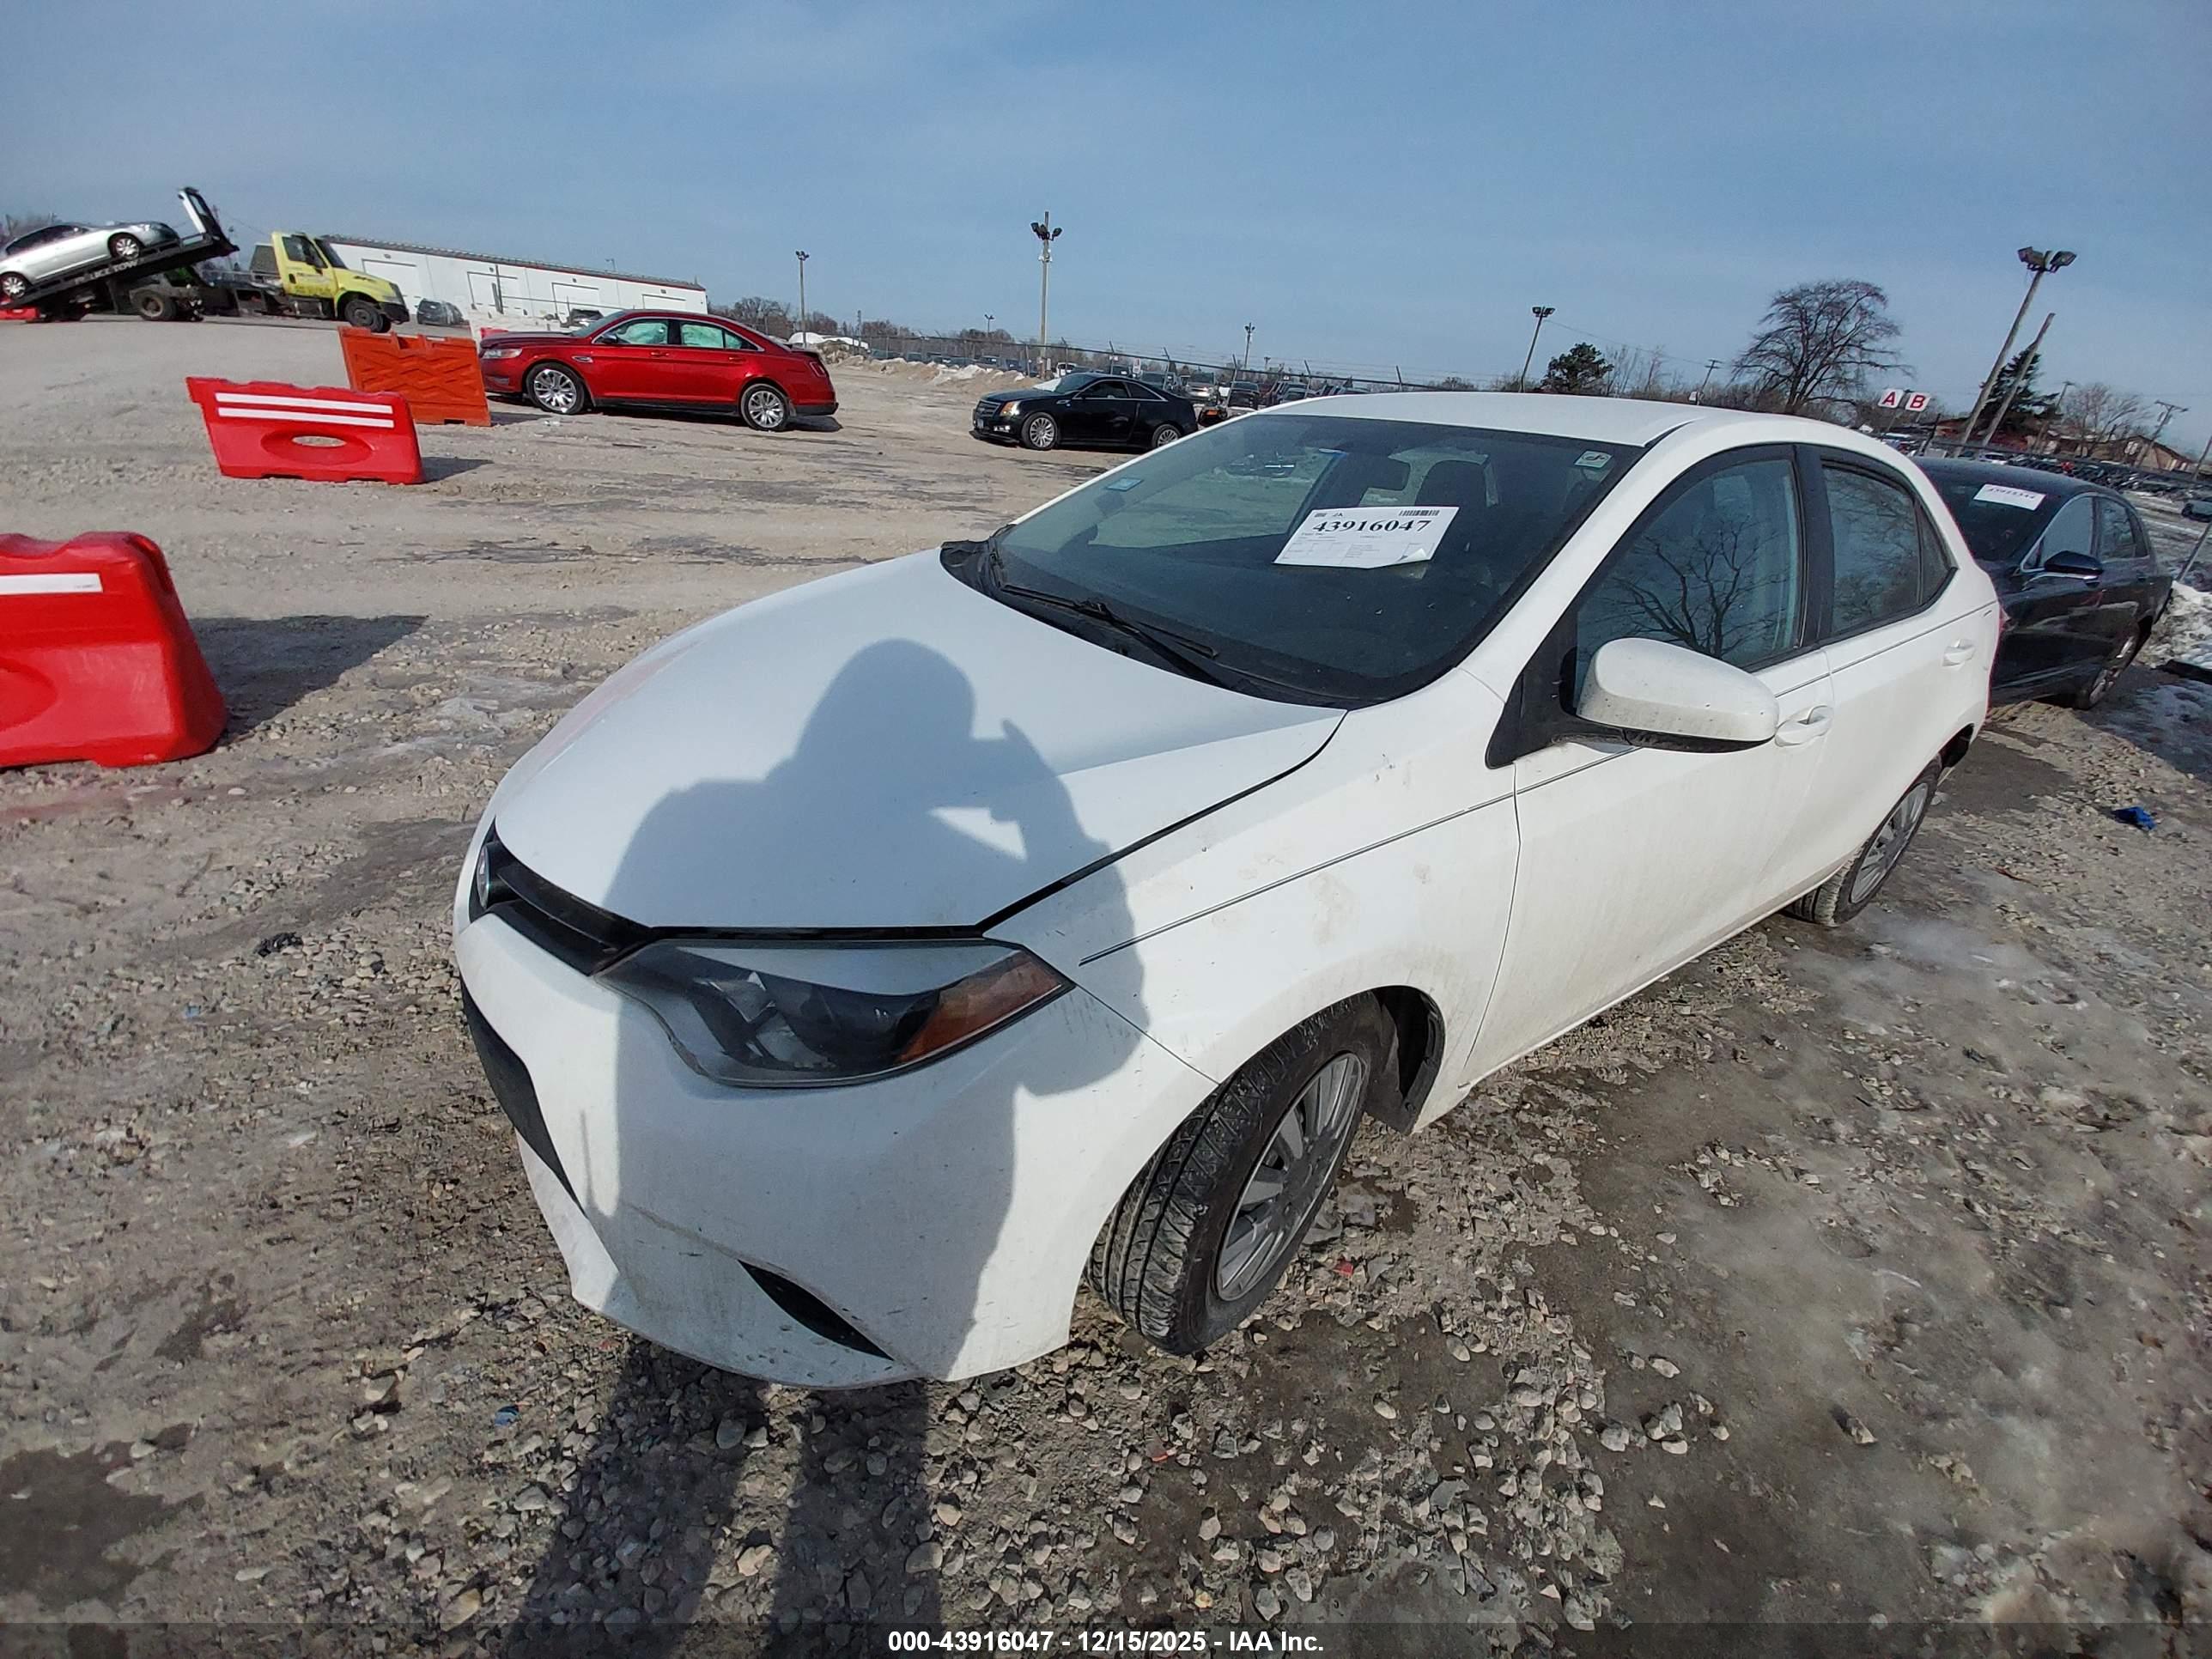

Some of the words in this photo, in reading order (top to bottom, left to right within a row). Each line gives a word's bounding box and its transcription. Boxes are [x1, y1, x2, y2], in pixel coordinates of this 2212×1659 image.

[1882, 392, 1896, 405] A
[1910, 394, 1926, 409] B
[1313, 520, 1431, 532] 43916047
